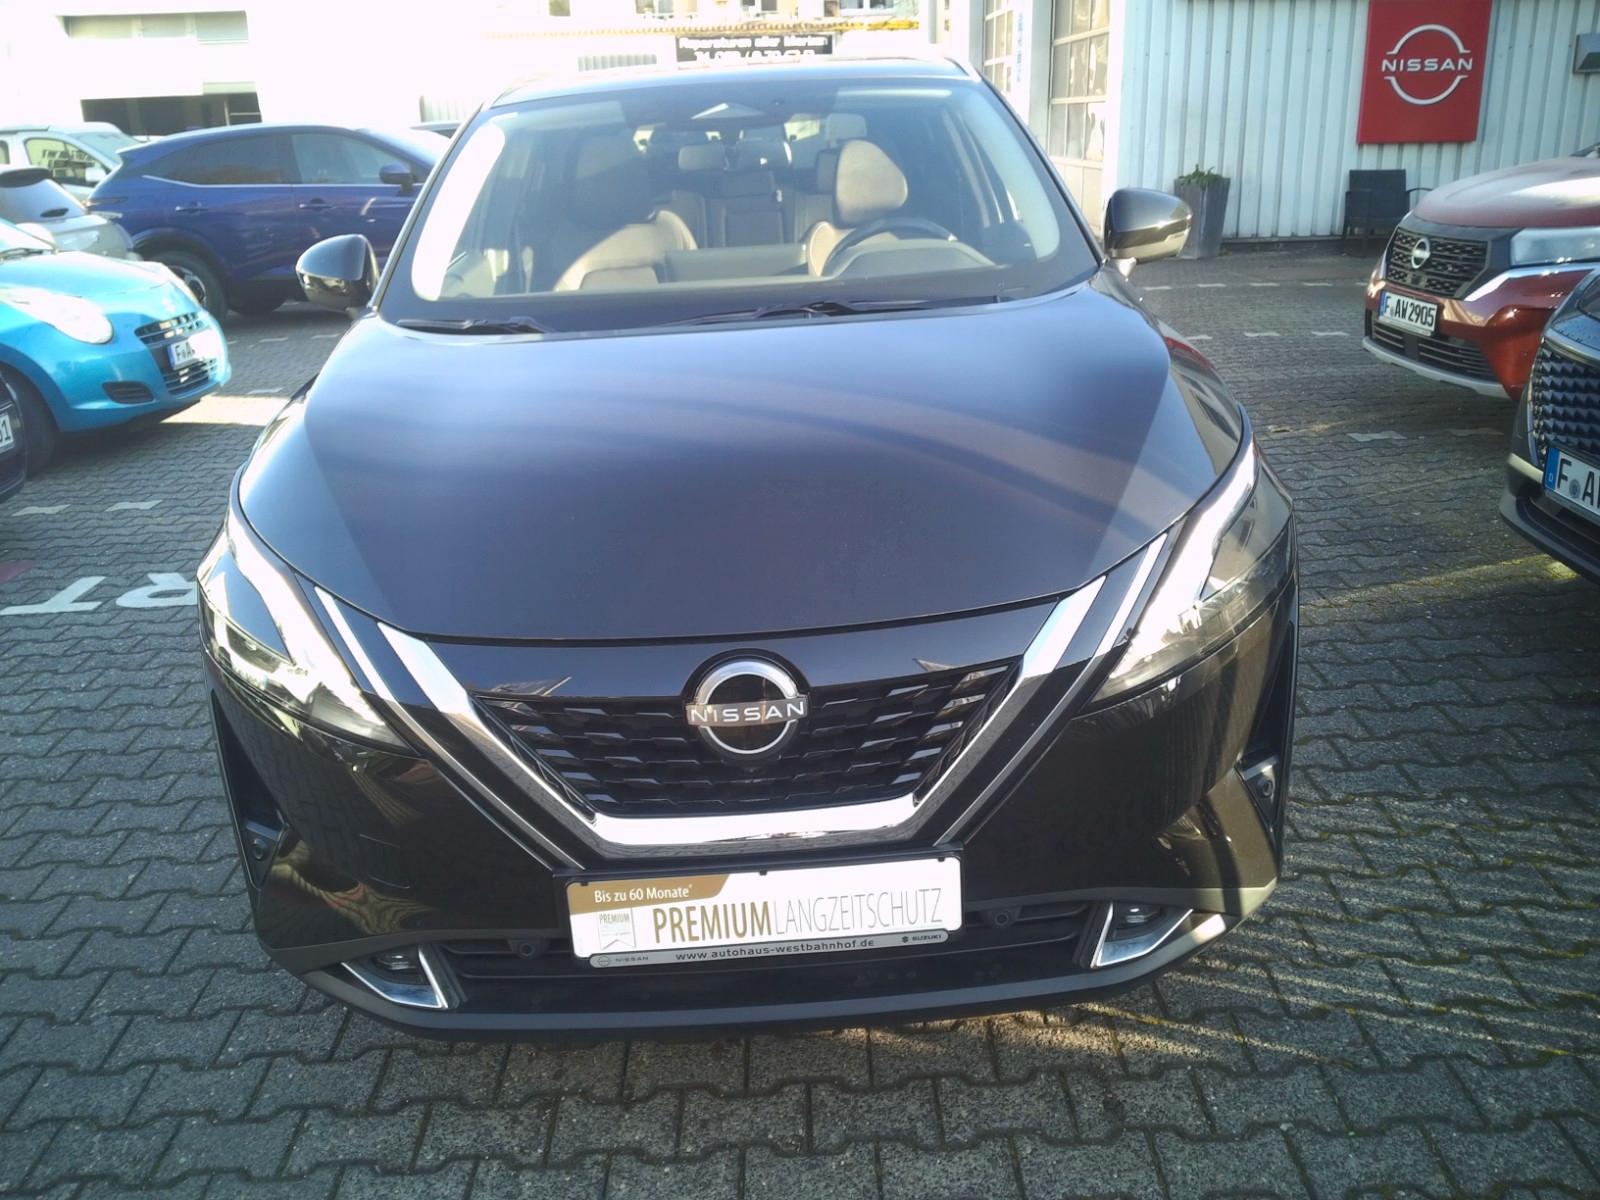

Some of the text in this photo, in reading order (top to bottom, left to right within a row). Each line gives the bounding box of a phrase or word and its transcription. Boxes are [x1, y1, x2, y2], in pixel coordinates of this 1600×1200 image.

[1381, 58, 1473, 73] NISSAN
[1557, 458, 1572, 489] F
[691, 701, 804, 723] NISSAN
[594, 889, 612, 903] Bis
[614, 891, 627, 902] zu
[629, 888, 643, 901] 60
[599, 912, 630, 925] PREMIUM
[676, 938, 875, 961] www.autohaus-westbahnhof.de
[615, 955, 649, 963] NISSAN
